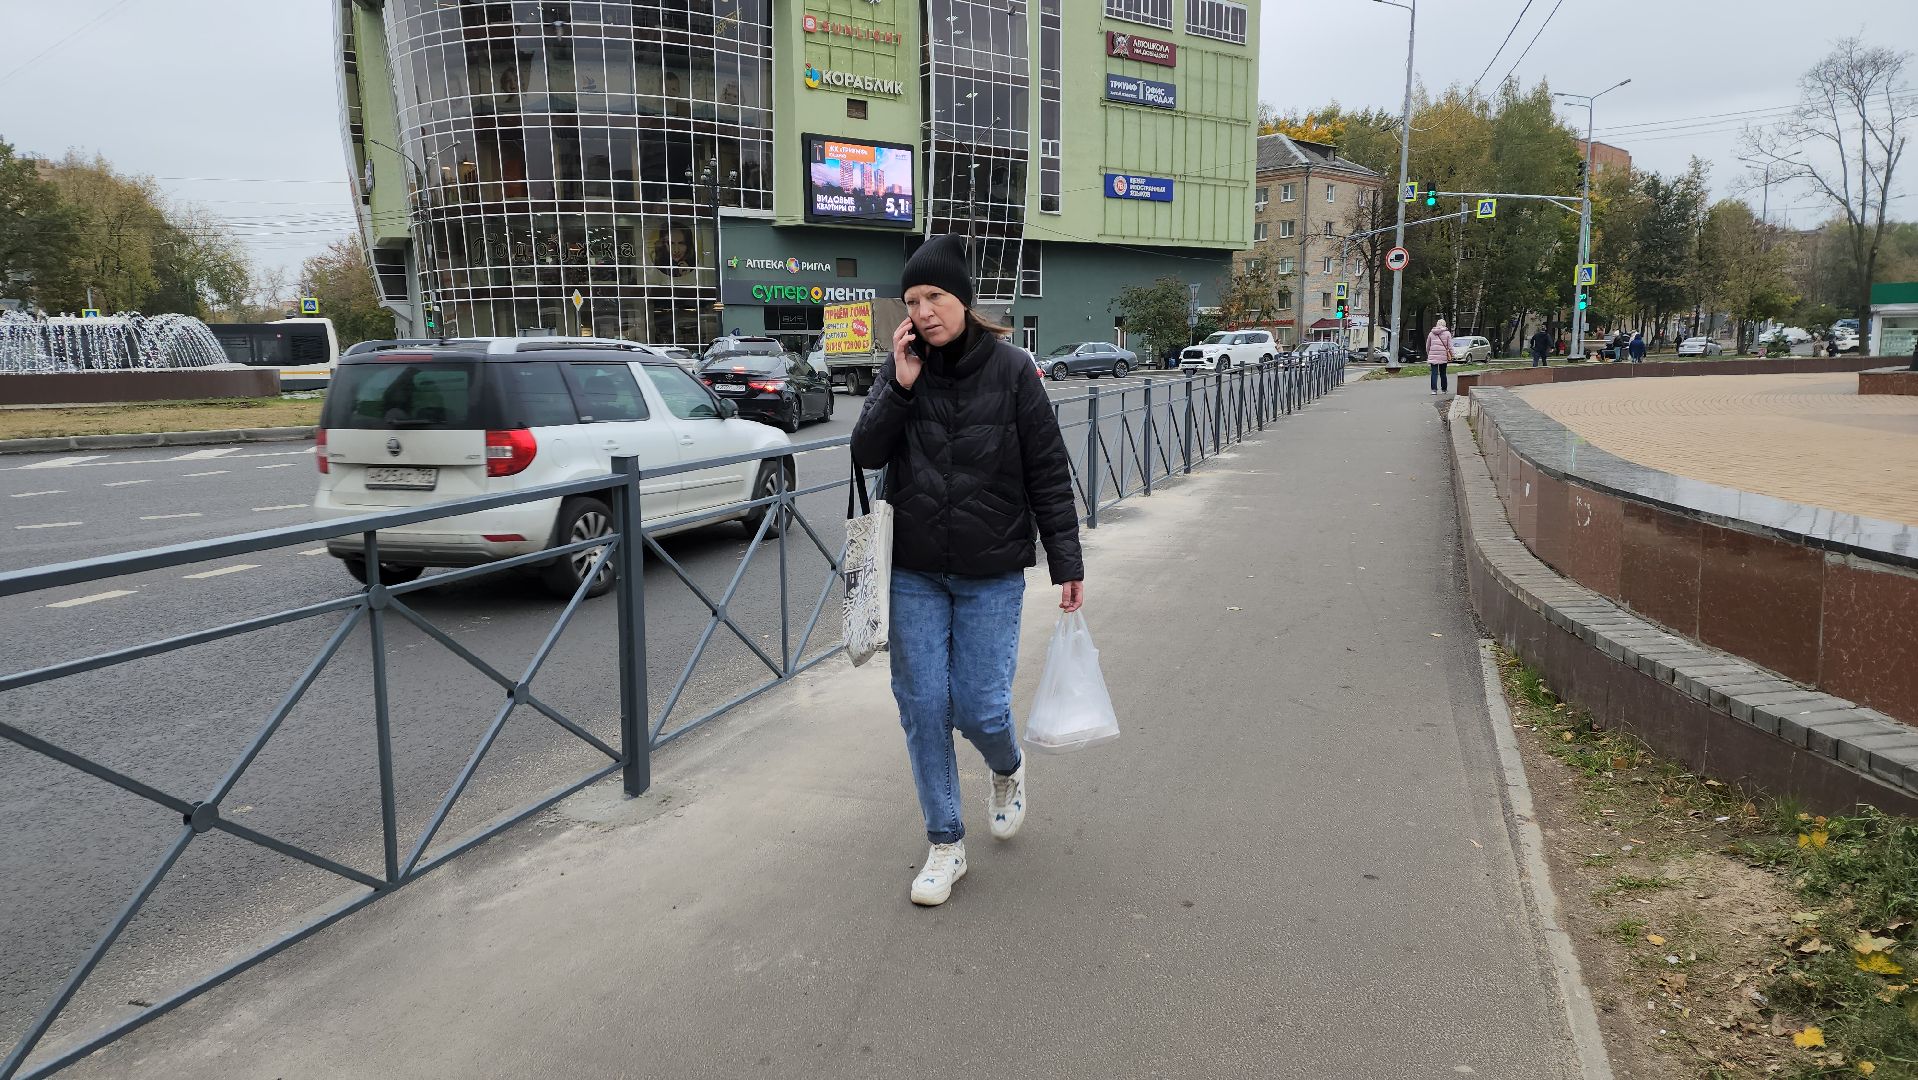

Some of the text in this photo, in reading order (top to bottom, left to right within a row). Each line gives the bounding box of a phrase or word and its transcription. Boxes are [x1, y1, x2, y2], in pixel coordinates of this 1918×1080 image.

[822, 20, 903, 46] SUNLIGHT
[822, 70, 904, 95] КОРАБЛИК
[1145, 86, 1165, 96] ОФИС
[1145, 93, 1174, 104] ПРОДАЖ
[816, 194, 855, 205] ВИДОВЫЕ
[745, 258, 831, 272] АПТЕКА РИГЛА
[752, 284, 876, 304] супер лента
